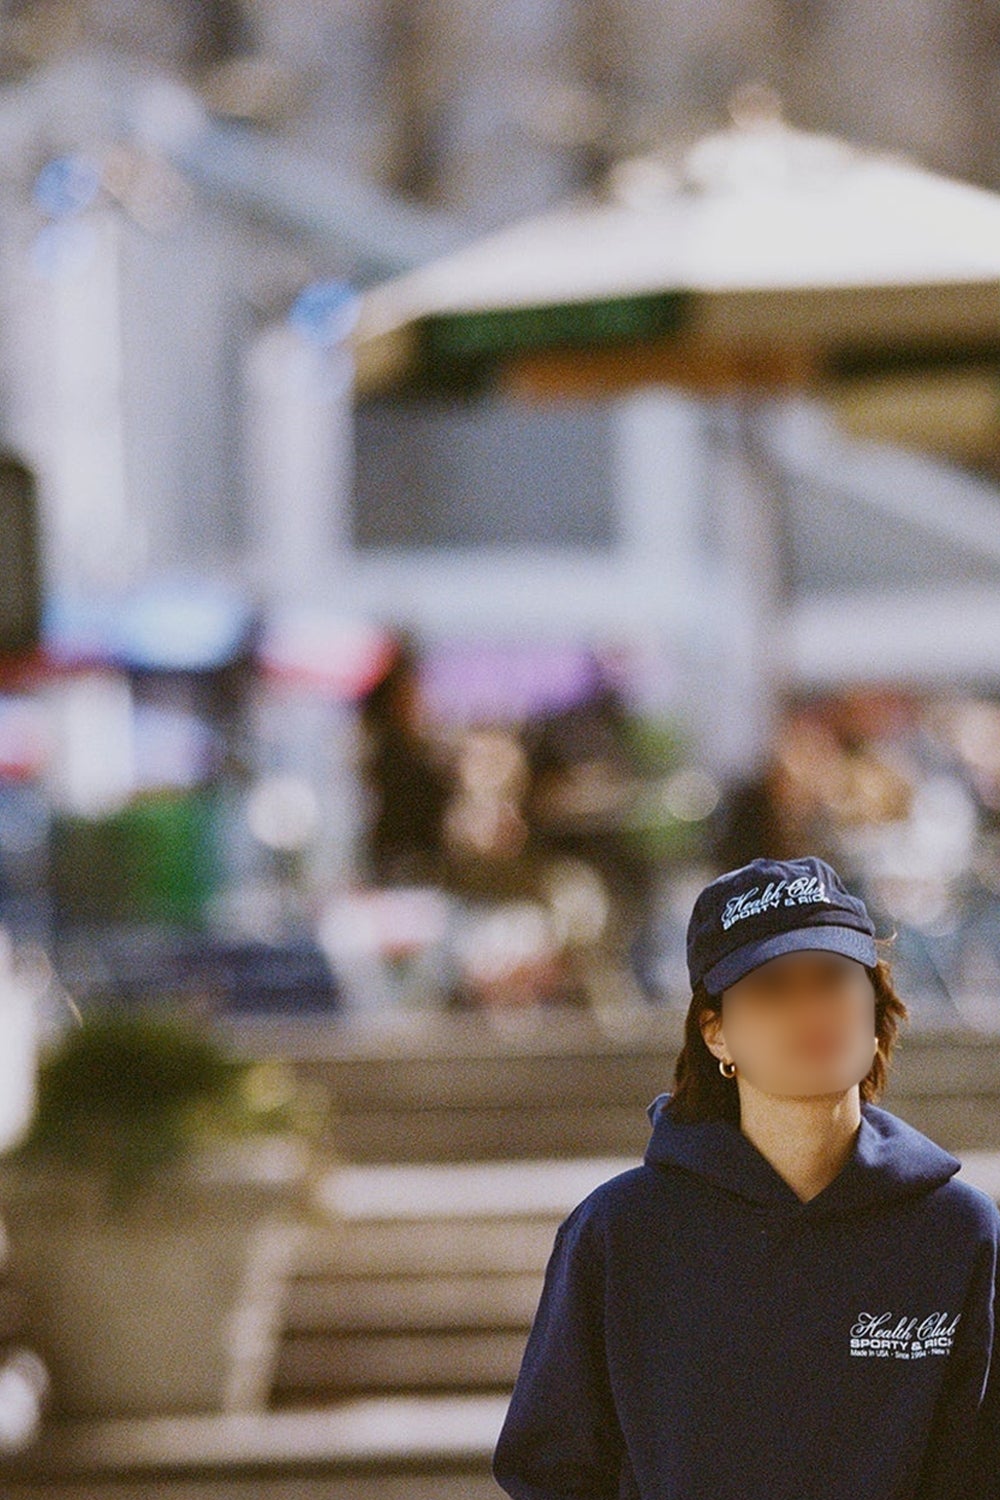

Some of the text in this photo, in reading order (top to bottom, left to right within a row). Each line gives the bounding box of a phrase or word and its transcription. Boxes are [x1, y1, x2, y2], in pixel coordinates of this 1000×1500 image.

[721, 880, 787, 922] Health
[723, 899, 780, 930] SPORTY
[784, 898, 796, 906] &
[850, 1312, 961, 1341] Health Club
[850, 1338, 909, 1351] SPORTY
[911, 1341, 922, 1351] &
